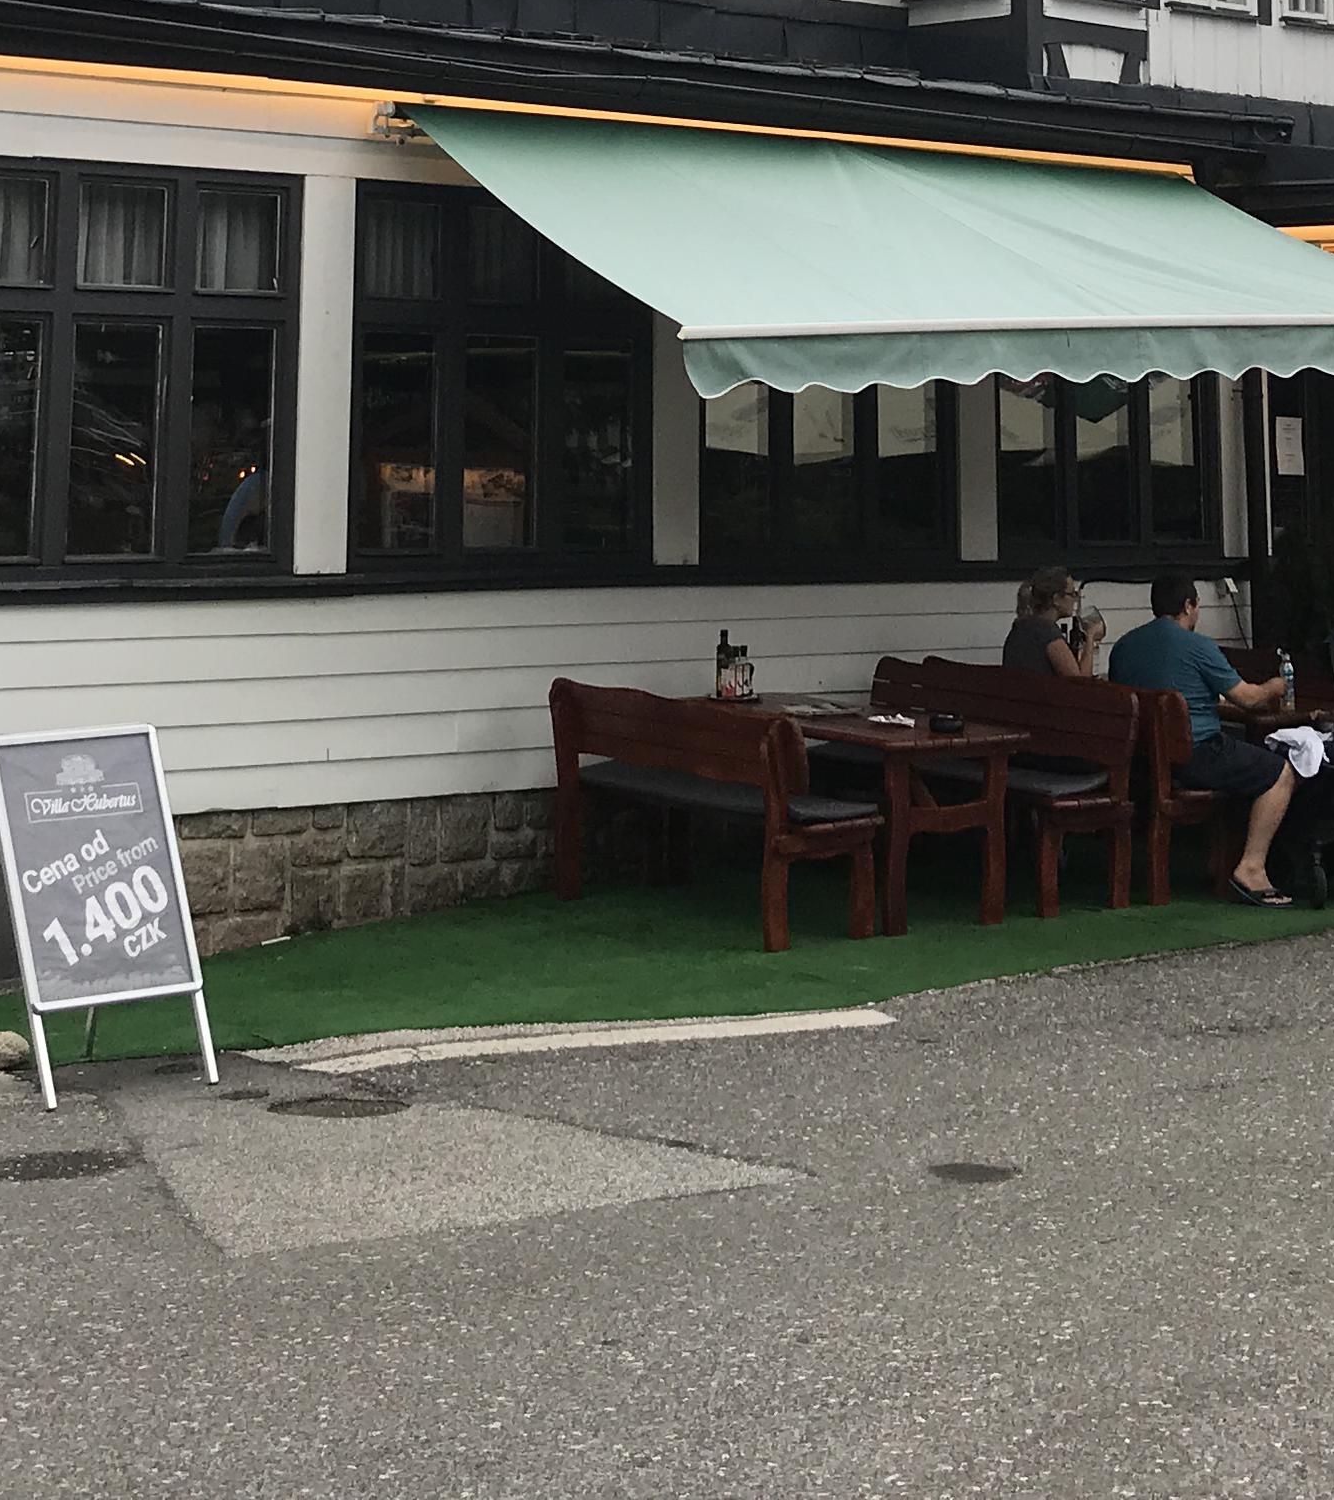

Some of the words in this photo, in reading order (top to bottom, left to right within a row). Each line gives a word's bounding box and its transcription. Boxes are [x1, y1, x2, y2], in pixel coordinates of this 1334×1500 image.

[30, 797, 69, 816] Villa
[71, 793, 136, 812] Hubertus
[22, 853, 80, 893] Cena
[80, 829, 110, 862] od
[71, 859, 119, 895] Price
[116, 837, 158, 867] from
[43, 865, 168, 966] 1.400
[123, 916, 168, 957] CZK
